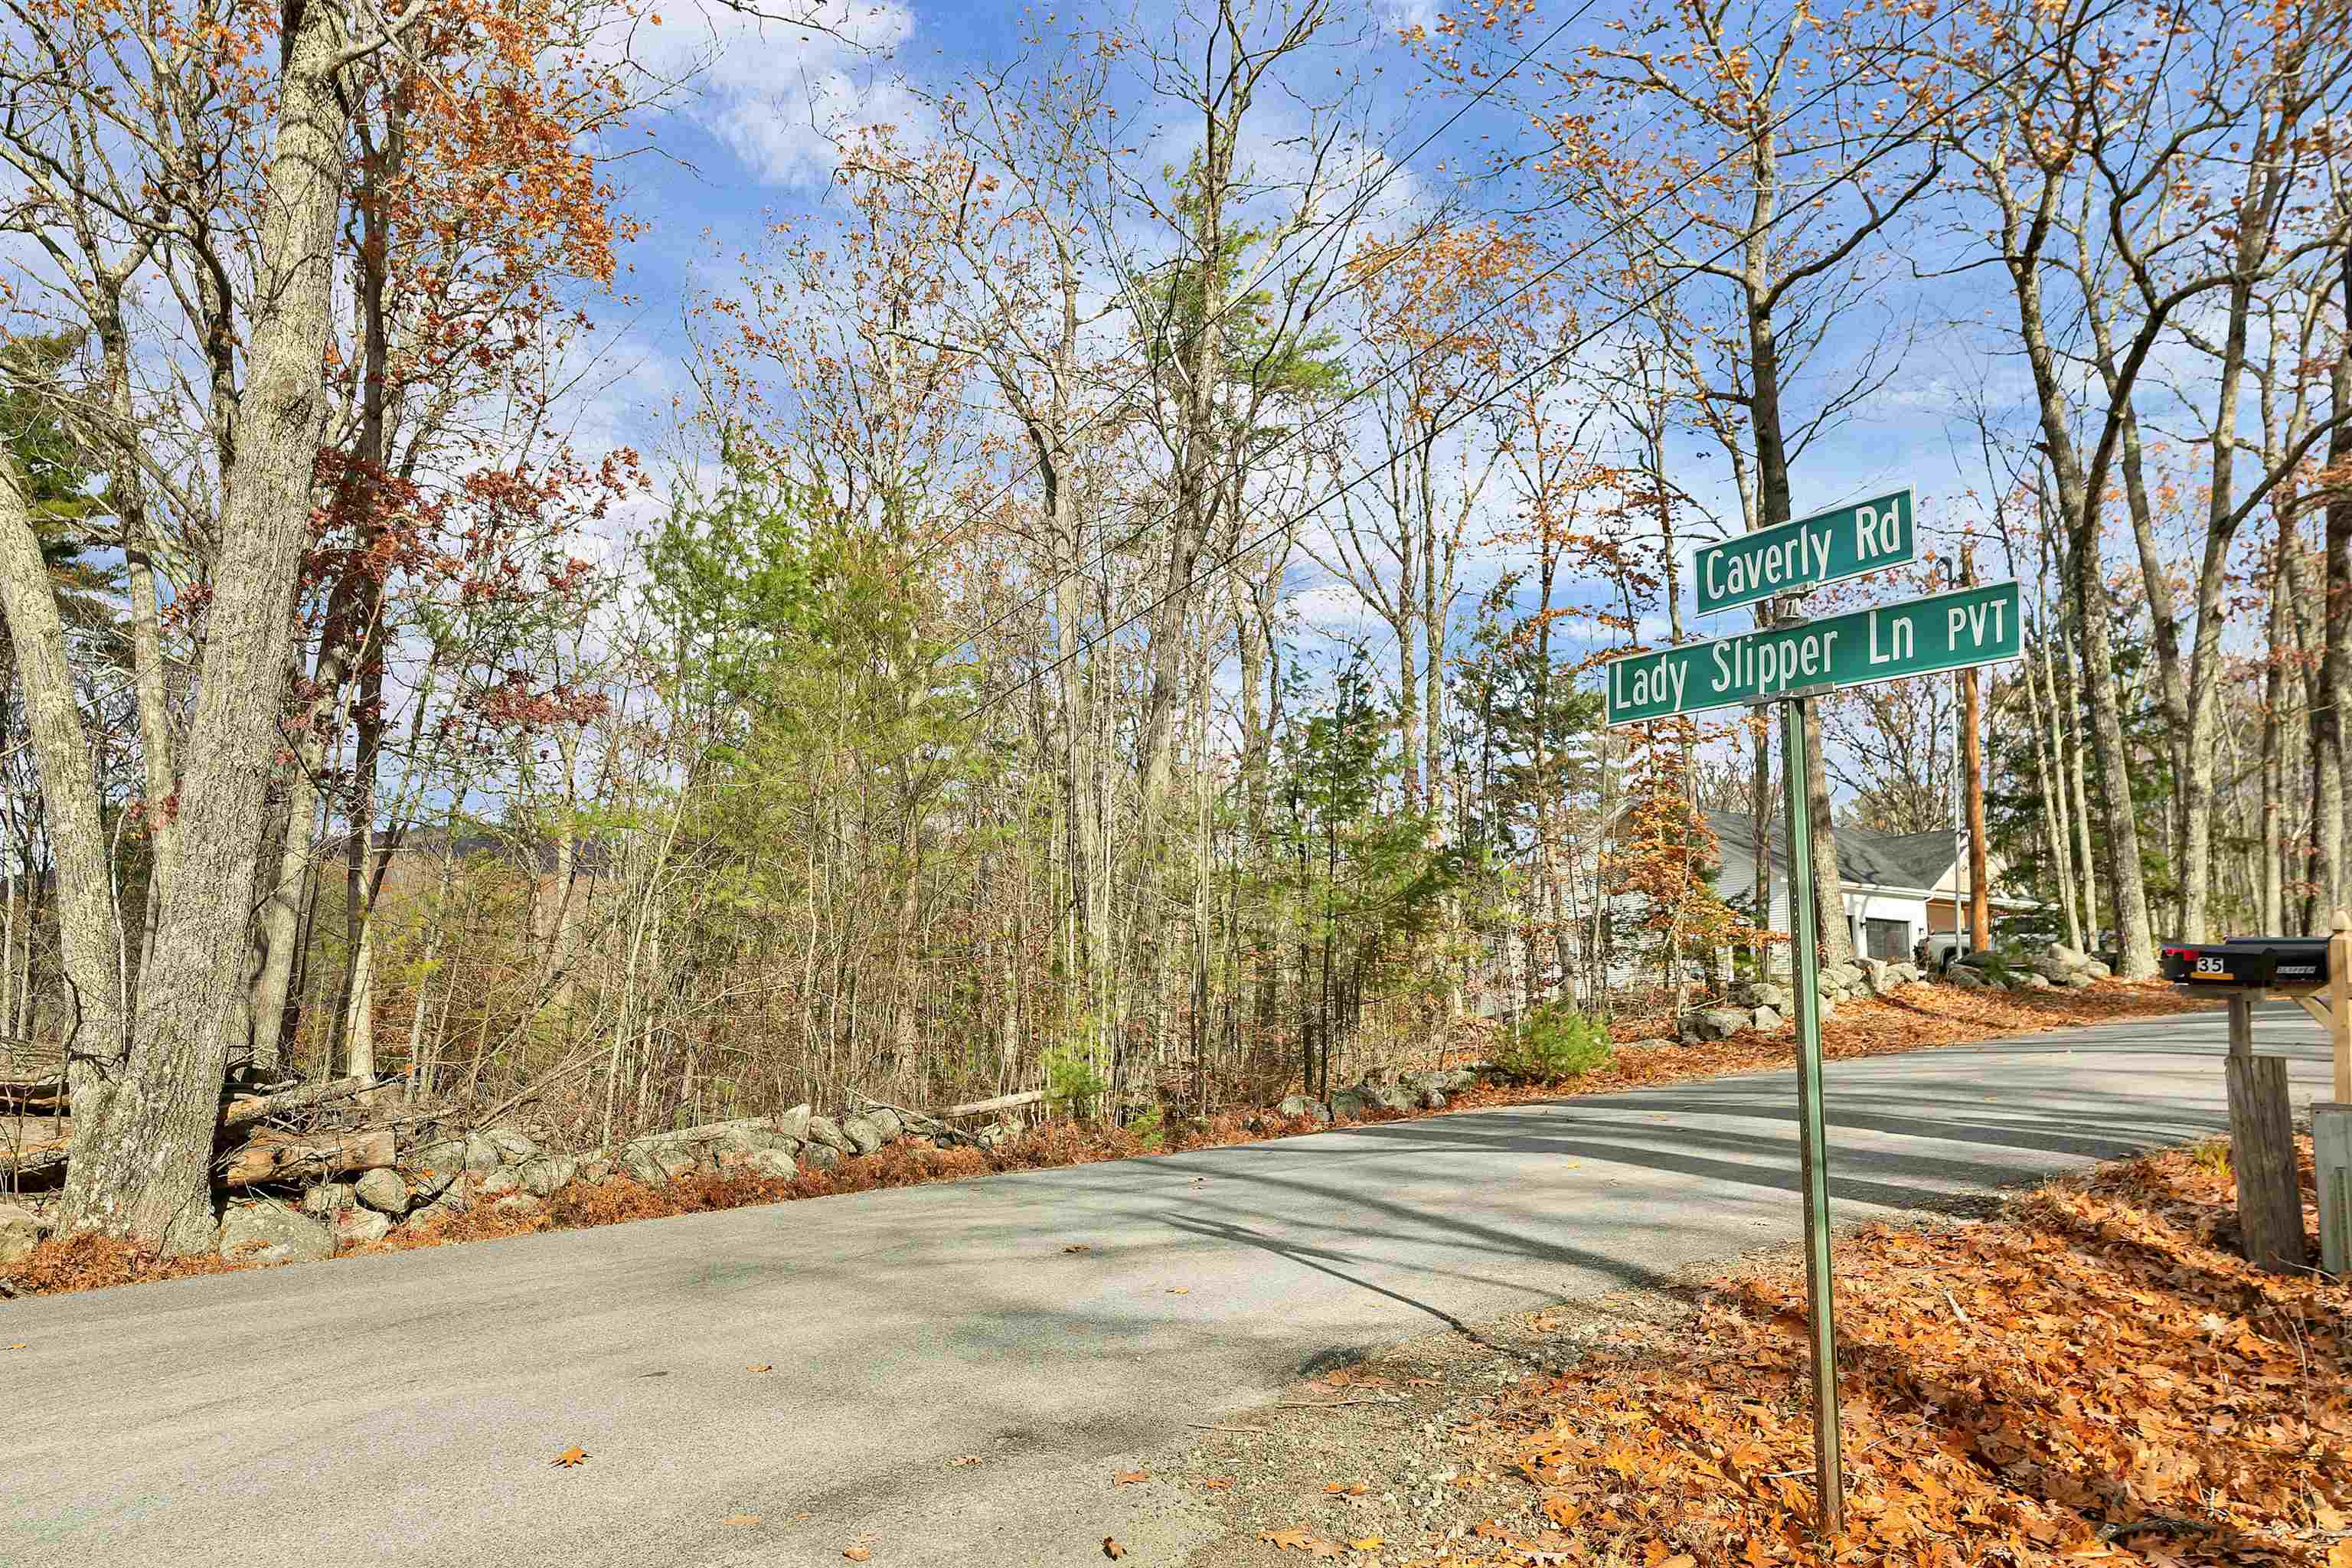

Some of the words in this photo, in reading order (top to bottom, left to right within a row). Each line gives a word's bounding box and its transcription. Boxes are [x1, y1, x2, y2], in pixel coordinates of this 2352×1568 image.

[1707, 524, 1832, 599] Caverly
[1856, 498, 1901, 561] Rd
[1615, 654, 1688, 712] Lady
[1712, 631, 1838, 694] Slipper
[1869, 611, 1914, 665] Ln
[1948, 599, 2007, 651] PVT
[2198, 958, 2222, 972] 35
